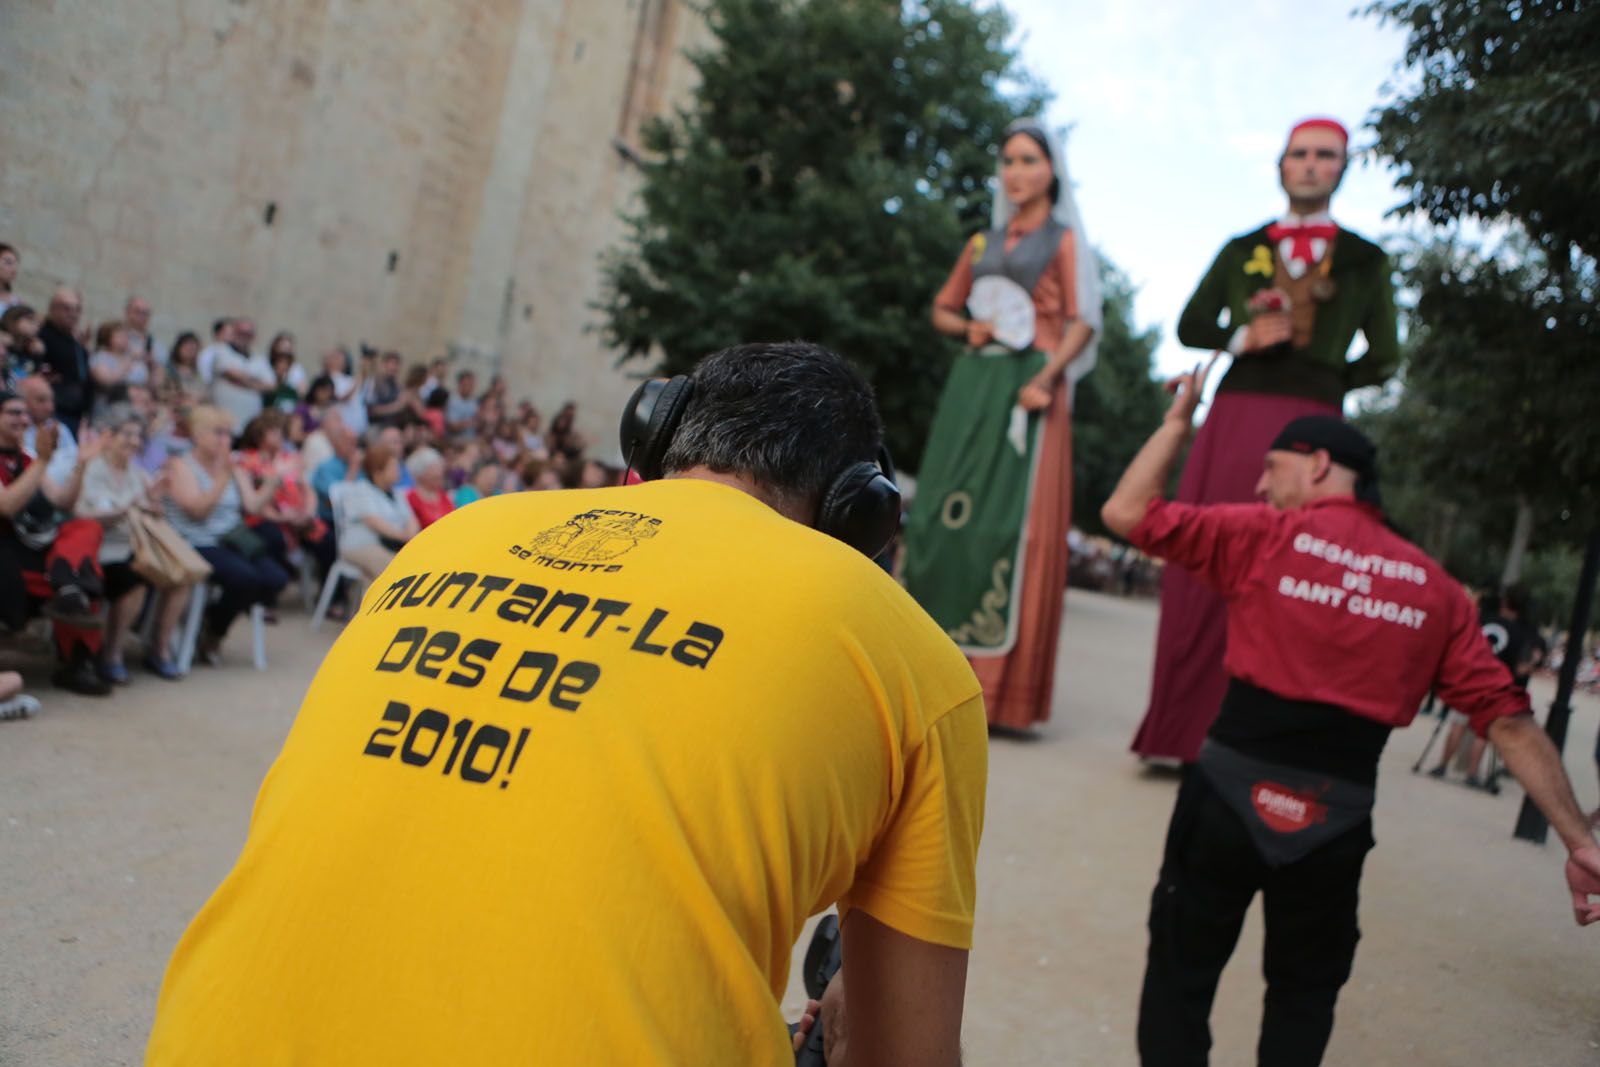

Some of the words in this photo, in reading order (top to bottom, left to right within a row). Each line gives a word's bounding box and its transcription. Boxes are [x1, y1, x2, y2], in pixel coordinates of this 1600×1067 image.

[1278, 575, 1347, 608] SANT
[1347, 594, 1428, 630] CUGAT
[1341, 570, 1373, 595] DE
[362, 700, 532, 790] 2010!
